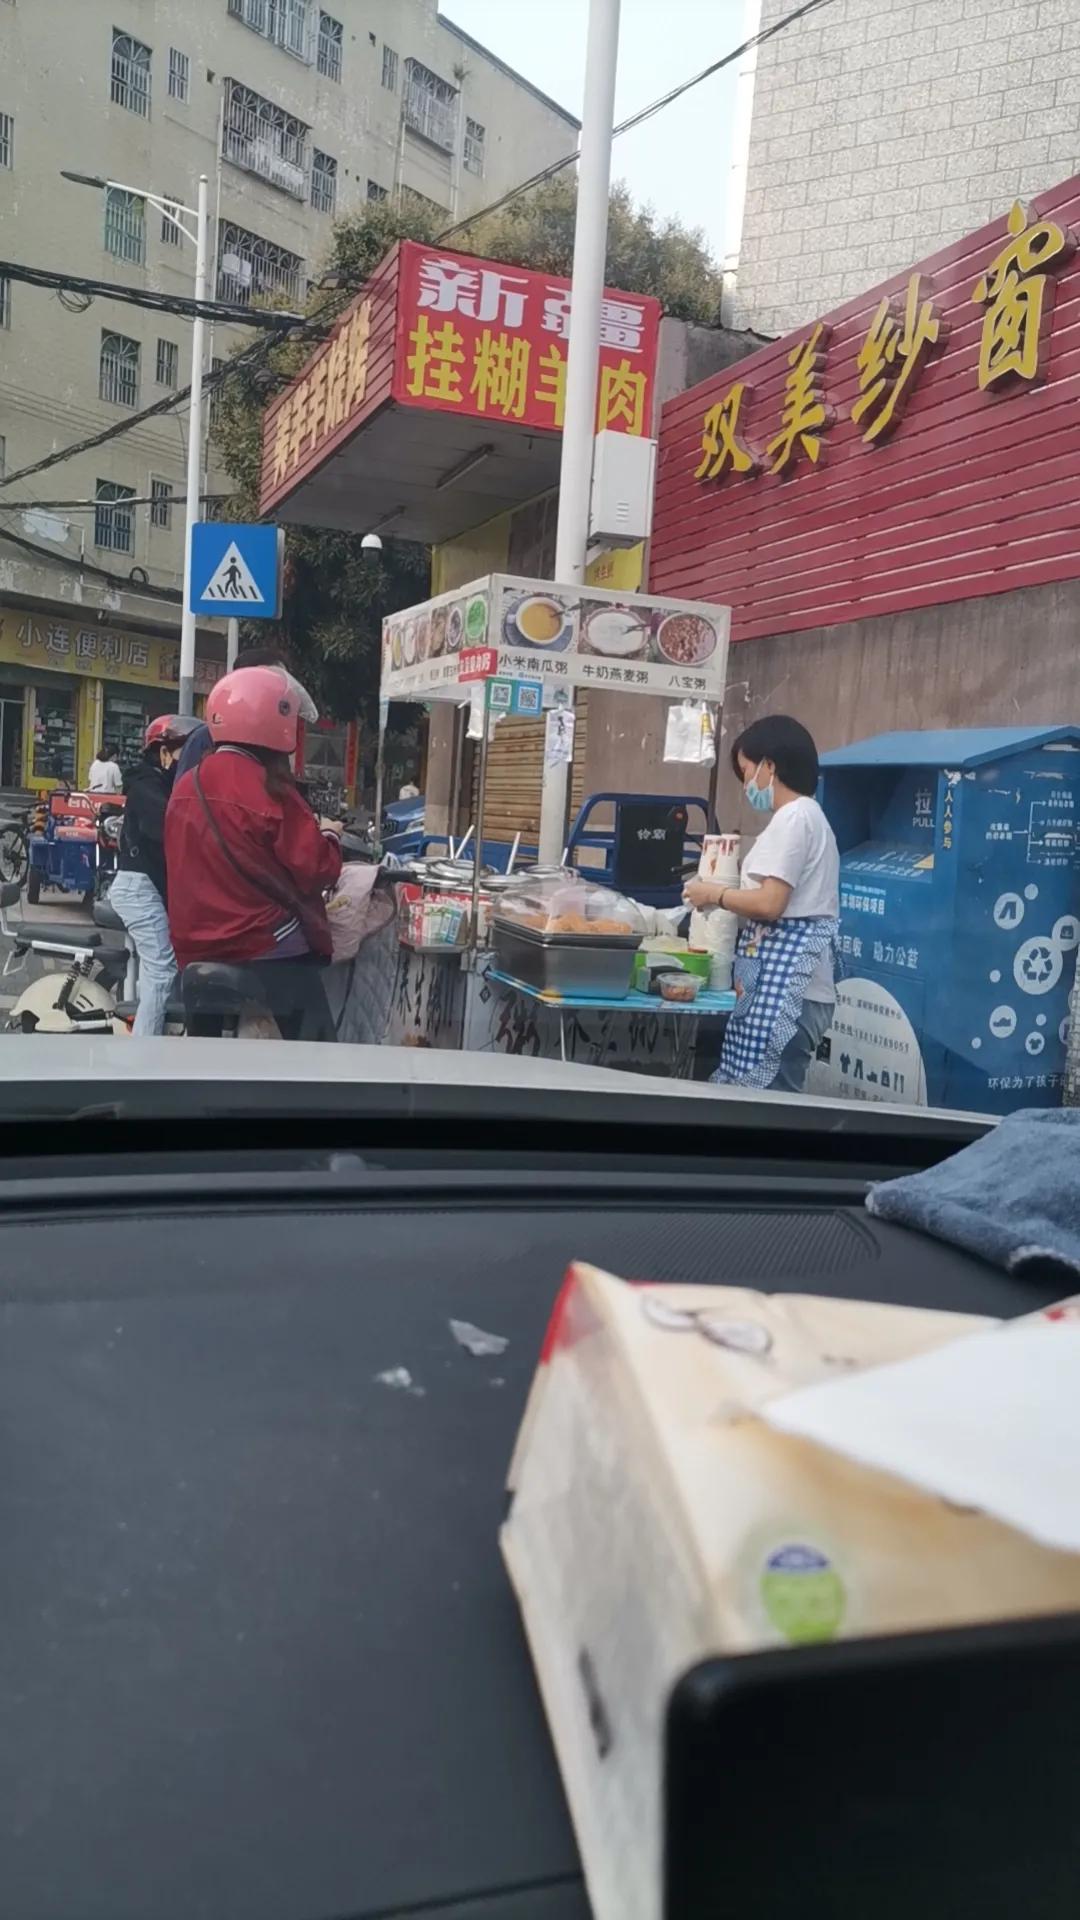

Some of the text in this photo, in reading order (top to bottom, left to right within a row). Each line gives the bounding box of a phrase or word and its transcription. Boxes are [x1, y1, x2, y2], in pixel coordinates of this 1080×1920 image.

[418, 257, 644, 353] 新疆
[694, 199, 1065, 479] 双美纱窗
[17, 618, 149, 667] 小连便利店
[498, 654, 569, 675] 小米南瓜粥
[582, 665, 649, 684] 牛奶燕麦粥
[668, 674, 708, 691] 八宝粥
[914, 788, 933, 815] 拉
[912, 816, 935, 828] PULL
